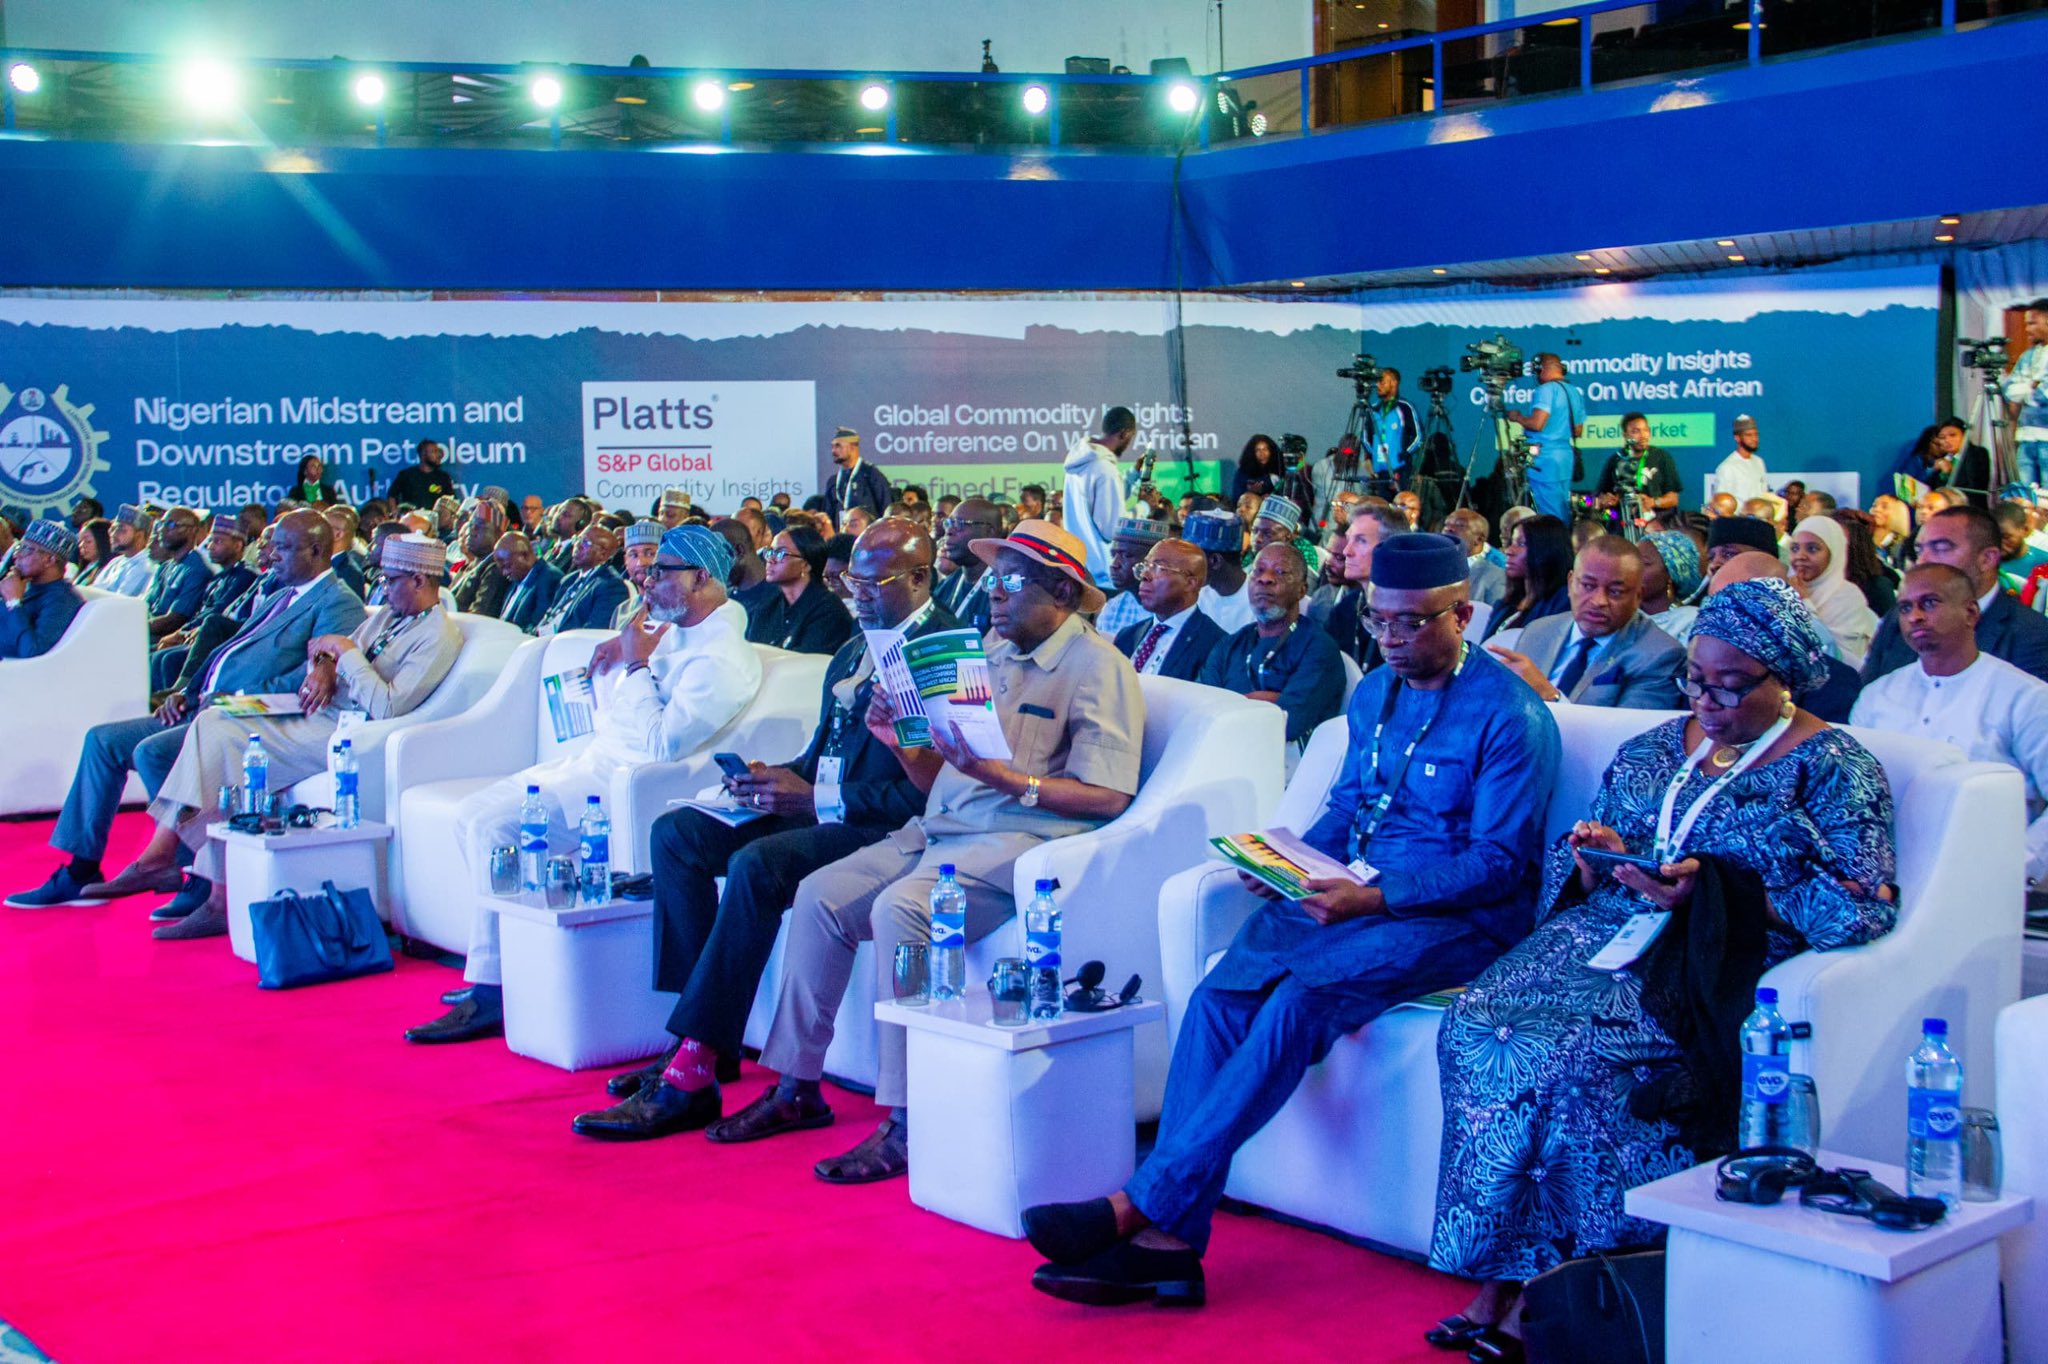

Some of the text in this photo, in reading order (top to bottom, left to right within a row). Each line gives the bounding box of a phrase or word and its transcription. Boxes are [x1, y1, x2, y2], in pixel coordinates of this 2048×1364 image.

[1560, 353, 1662, 377] mmodity
[1667, 350, 1752, 374] Insights
[1588, 382, 1617, 401] On
[1621, 380, 1679, 400] West
[1683, 377, 1763, 398] African
[134, 395, 524, 432] Nigerian Midstream and
[593, 396, 714, 430] Platts
[874, 402, 1194, 428] Global Commodity Iights
[875, 431, 1017, 454] Conference
[1023, 431, 1056, 452] On
[1587, 422, 1688, 439] Fuel rket
[360, 437, 527, 466] Petoleum
[597, 453, 713, 473] S&P Global
[722, 476, 802, 501] Insights
